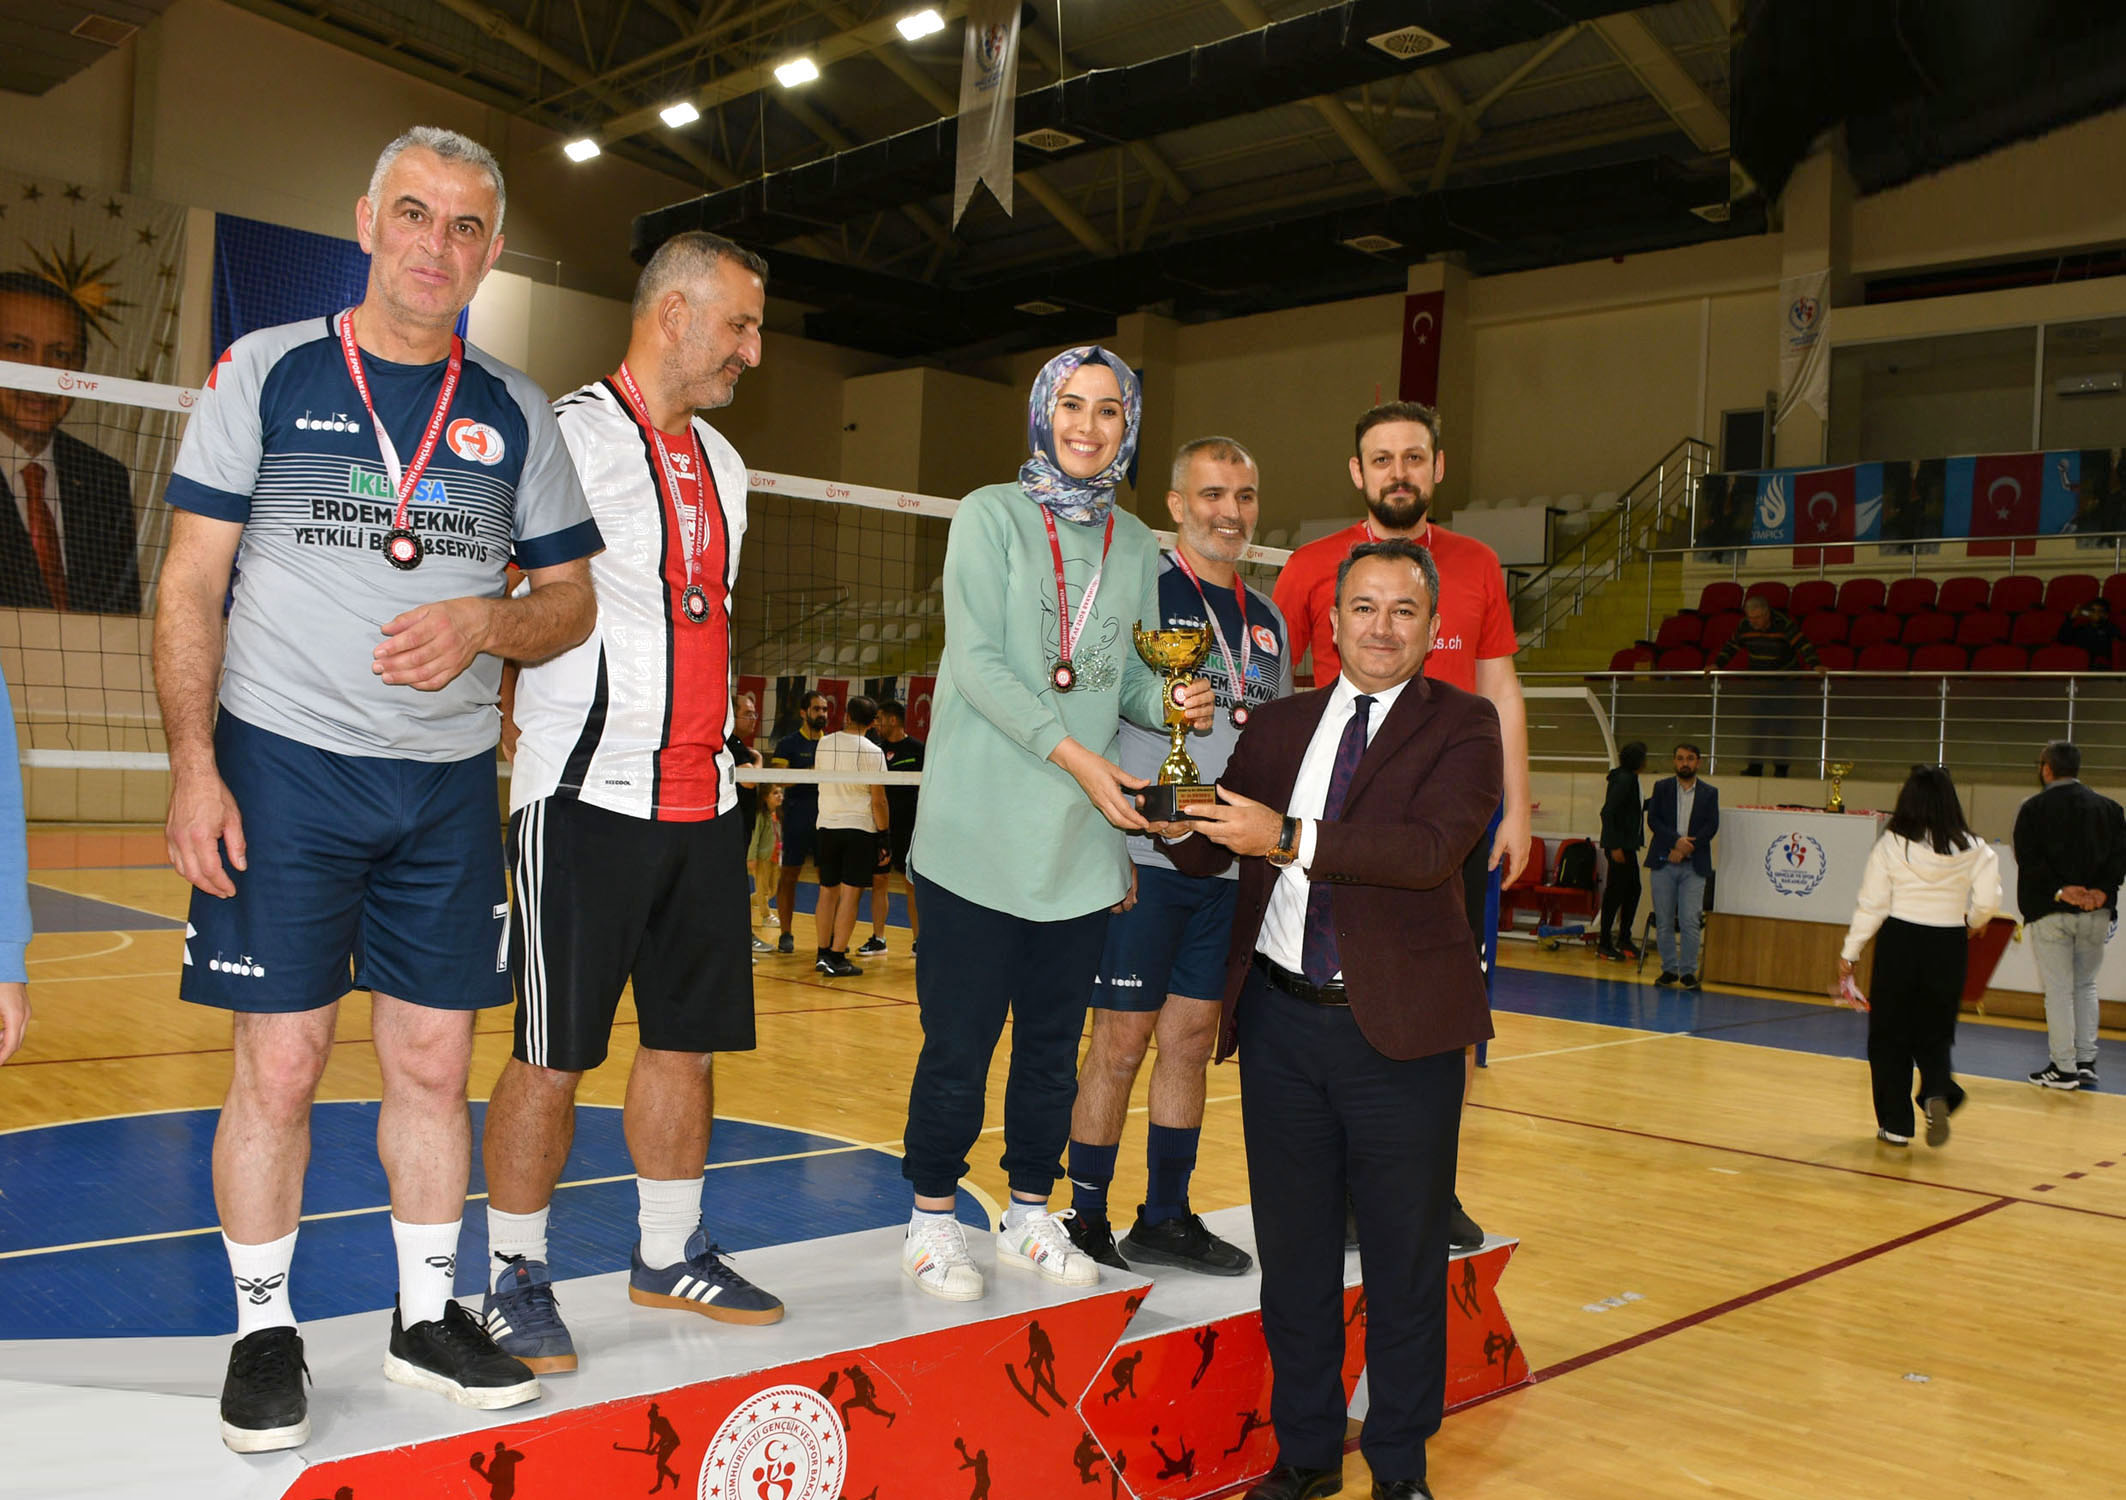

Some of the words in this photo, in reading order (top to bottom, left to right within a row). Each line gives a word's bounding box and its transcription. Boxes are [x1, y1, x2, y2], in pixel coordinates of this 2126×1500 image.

[76, 379, 99, 391] TVF
[295, 410, 360, 433] diadora
[432, 411, 445, 429] SPOR
[429, 427, 438, 440] VE
[414, 440, 435, 471] GENÇLİK
[762, 478, 776, 487] TVF
[836, 489, 850, 498] TVF
[907, 499, 921, 508] TVF
[311, 500, 391, 527] ERDEM
[294, 526, 363, 548] YETKİLİ
[209, 950, 265, 977] diadora
[762, 1421, 800, 1434] GENÇLİK
[800, 1428, 810, 1441] VE
[806, 1440, 818, 1466] SPOR
